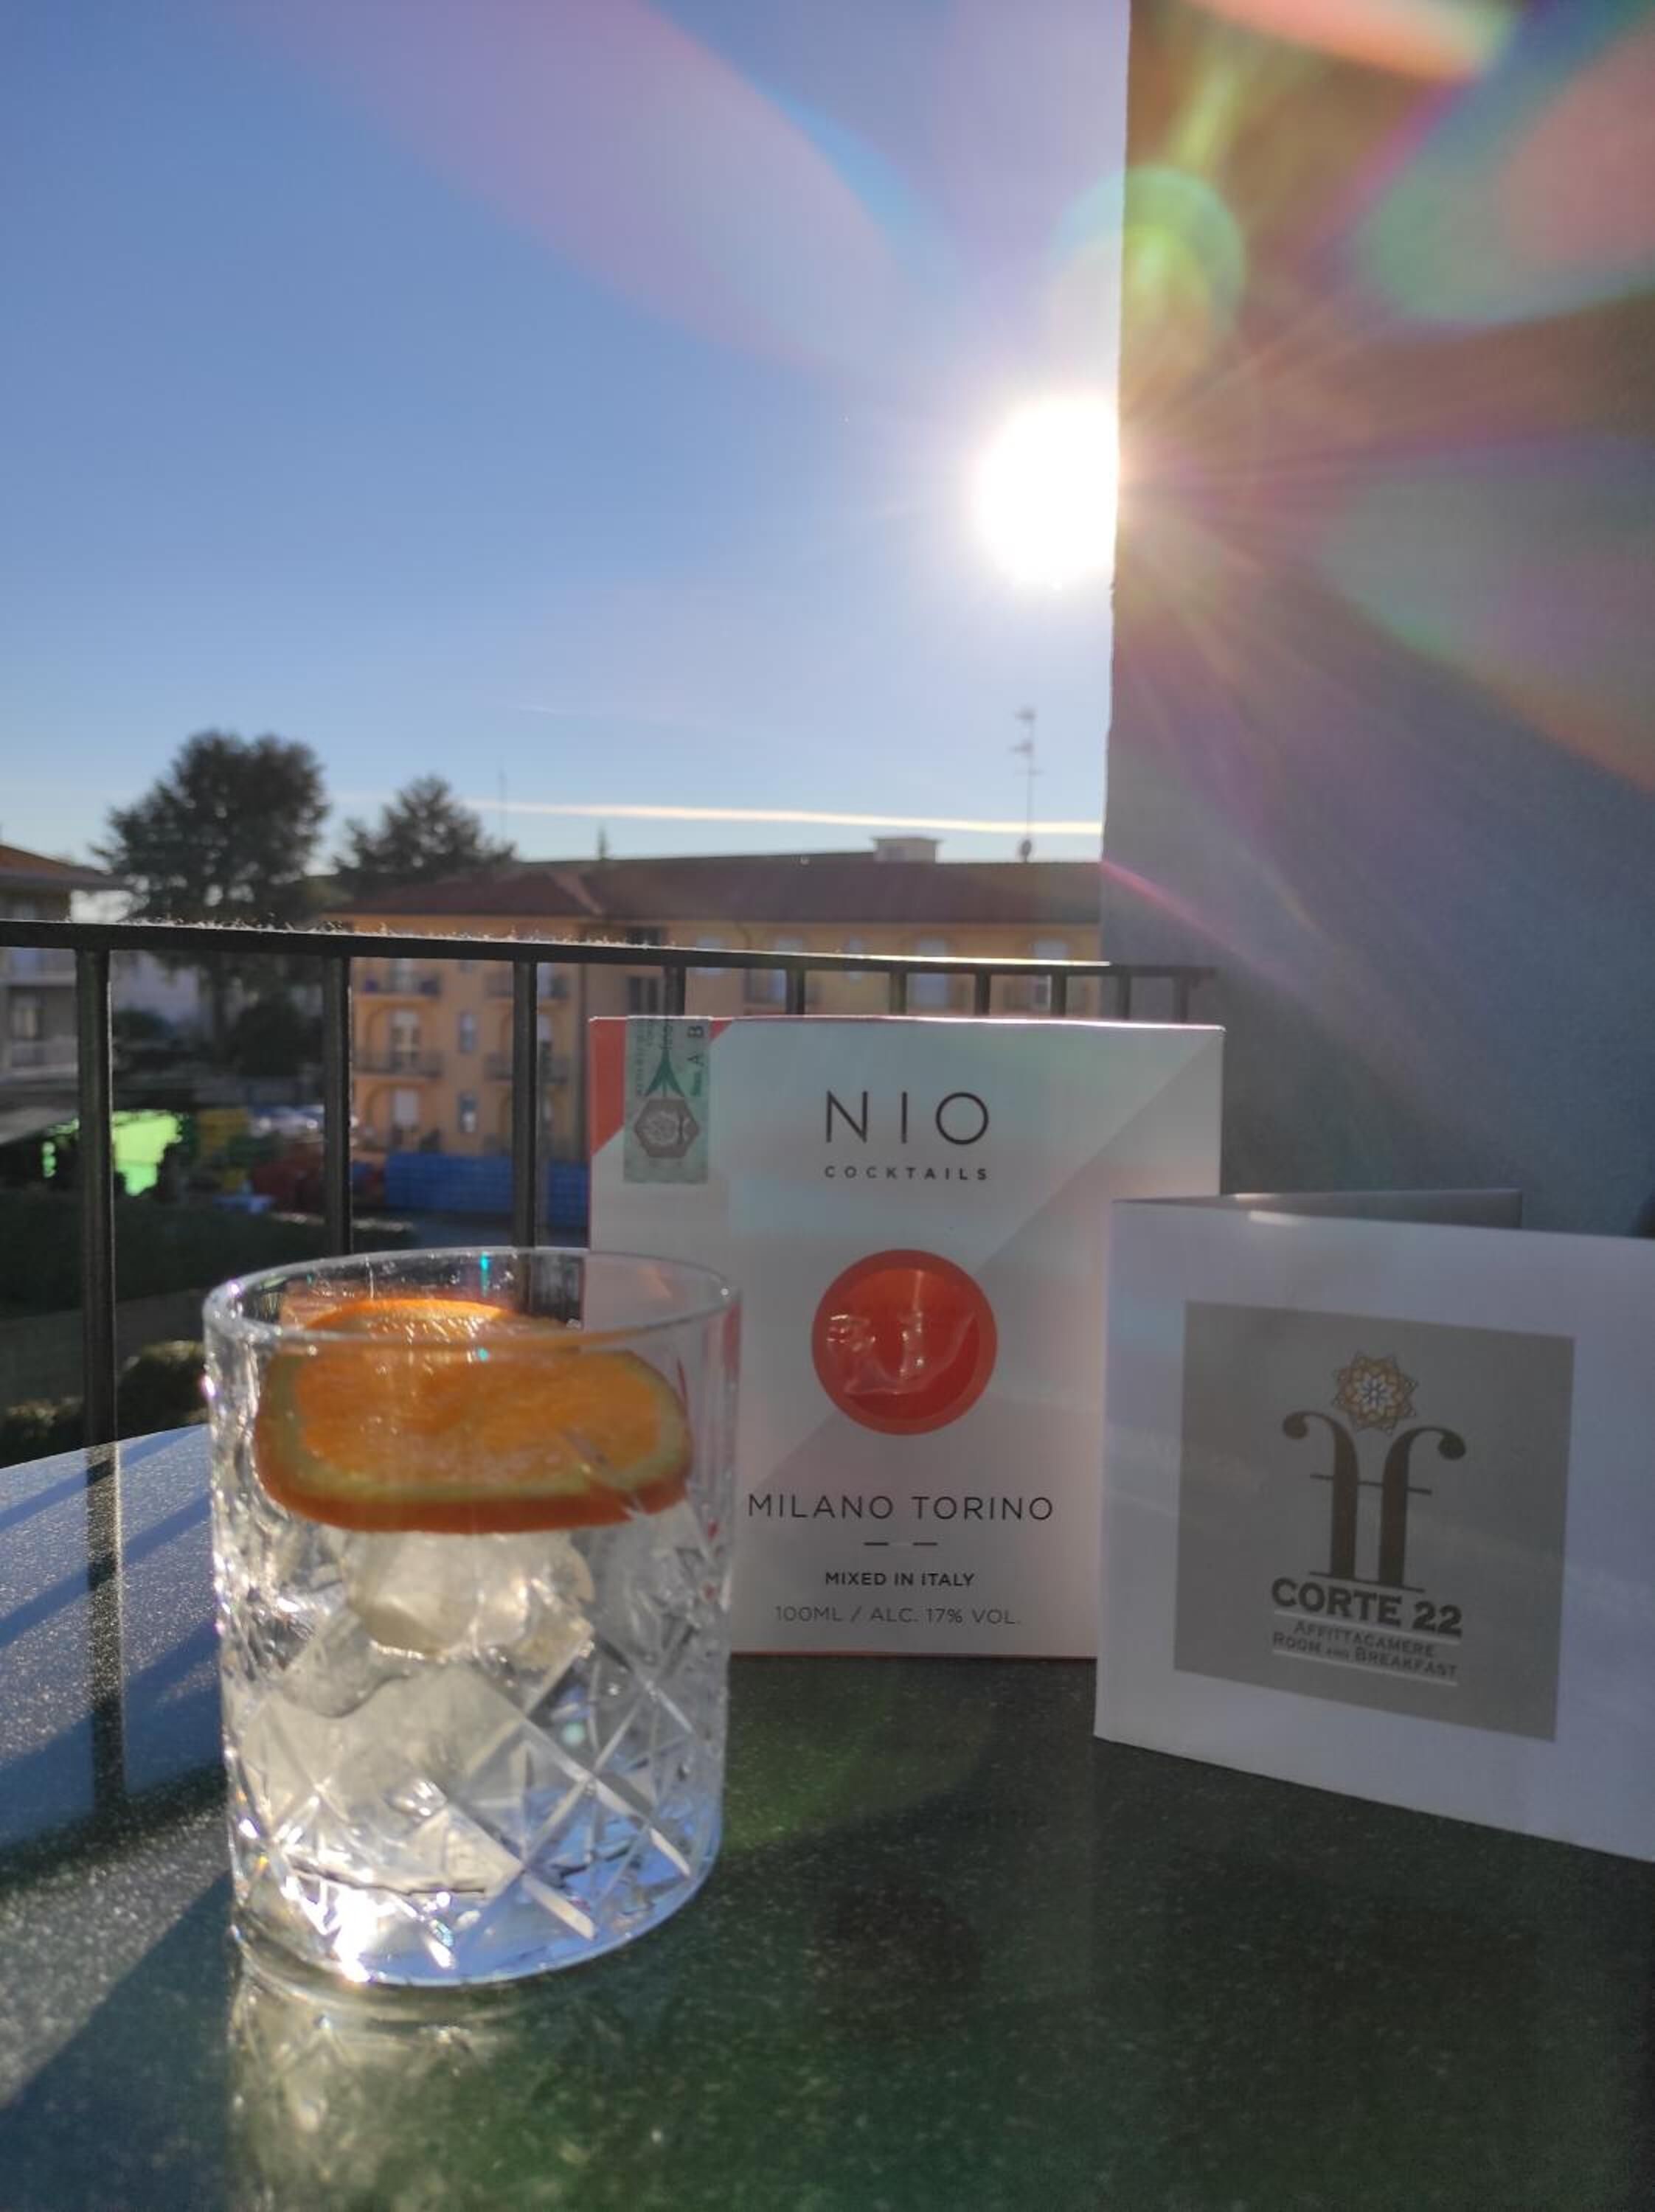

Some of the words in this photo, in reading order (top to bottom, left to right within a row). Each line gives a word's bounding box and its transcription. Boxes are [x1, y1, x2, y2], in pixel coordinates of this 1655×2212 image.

[826, 1090, 990, 1146] NIO
[824, 1165, 988, 1180] COCKTAILS
[747, 1492, 895, 1520] MILANO
[911, 1495, 1054, 1521] TORINO
[825, 1571, 887, 1587] MIXED
[894, 1572, 915, 1587] IN
[921, 1572, 975, 1587] ITALY
[775, 1605, 843, 1622] 100ML
[927, 1607, 963, 1624] 17%
[1271, 1576, 1403, 1628] CORTE
[1412, 1600, 1463, 1638] 22
